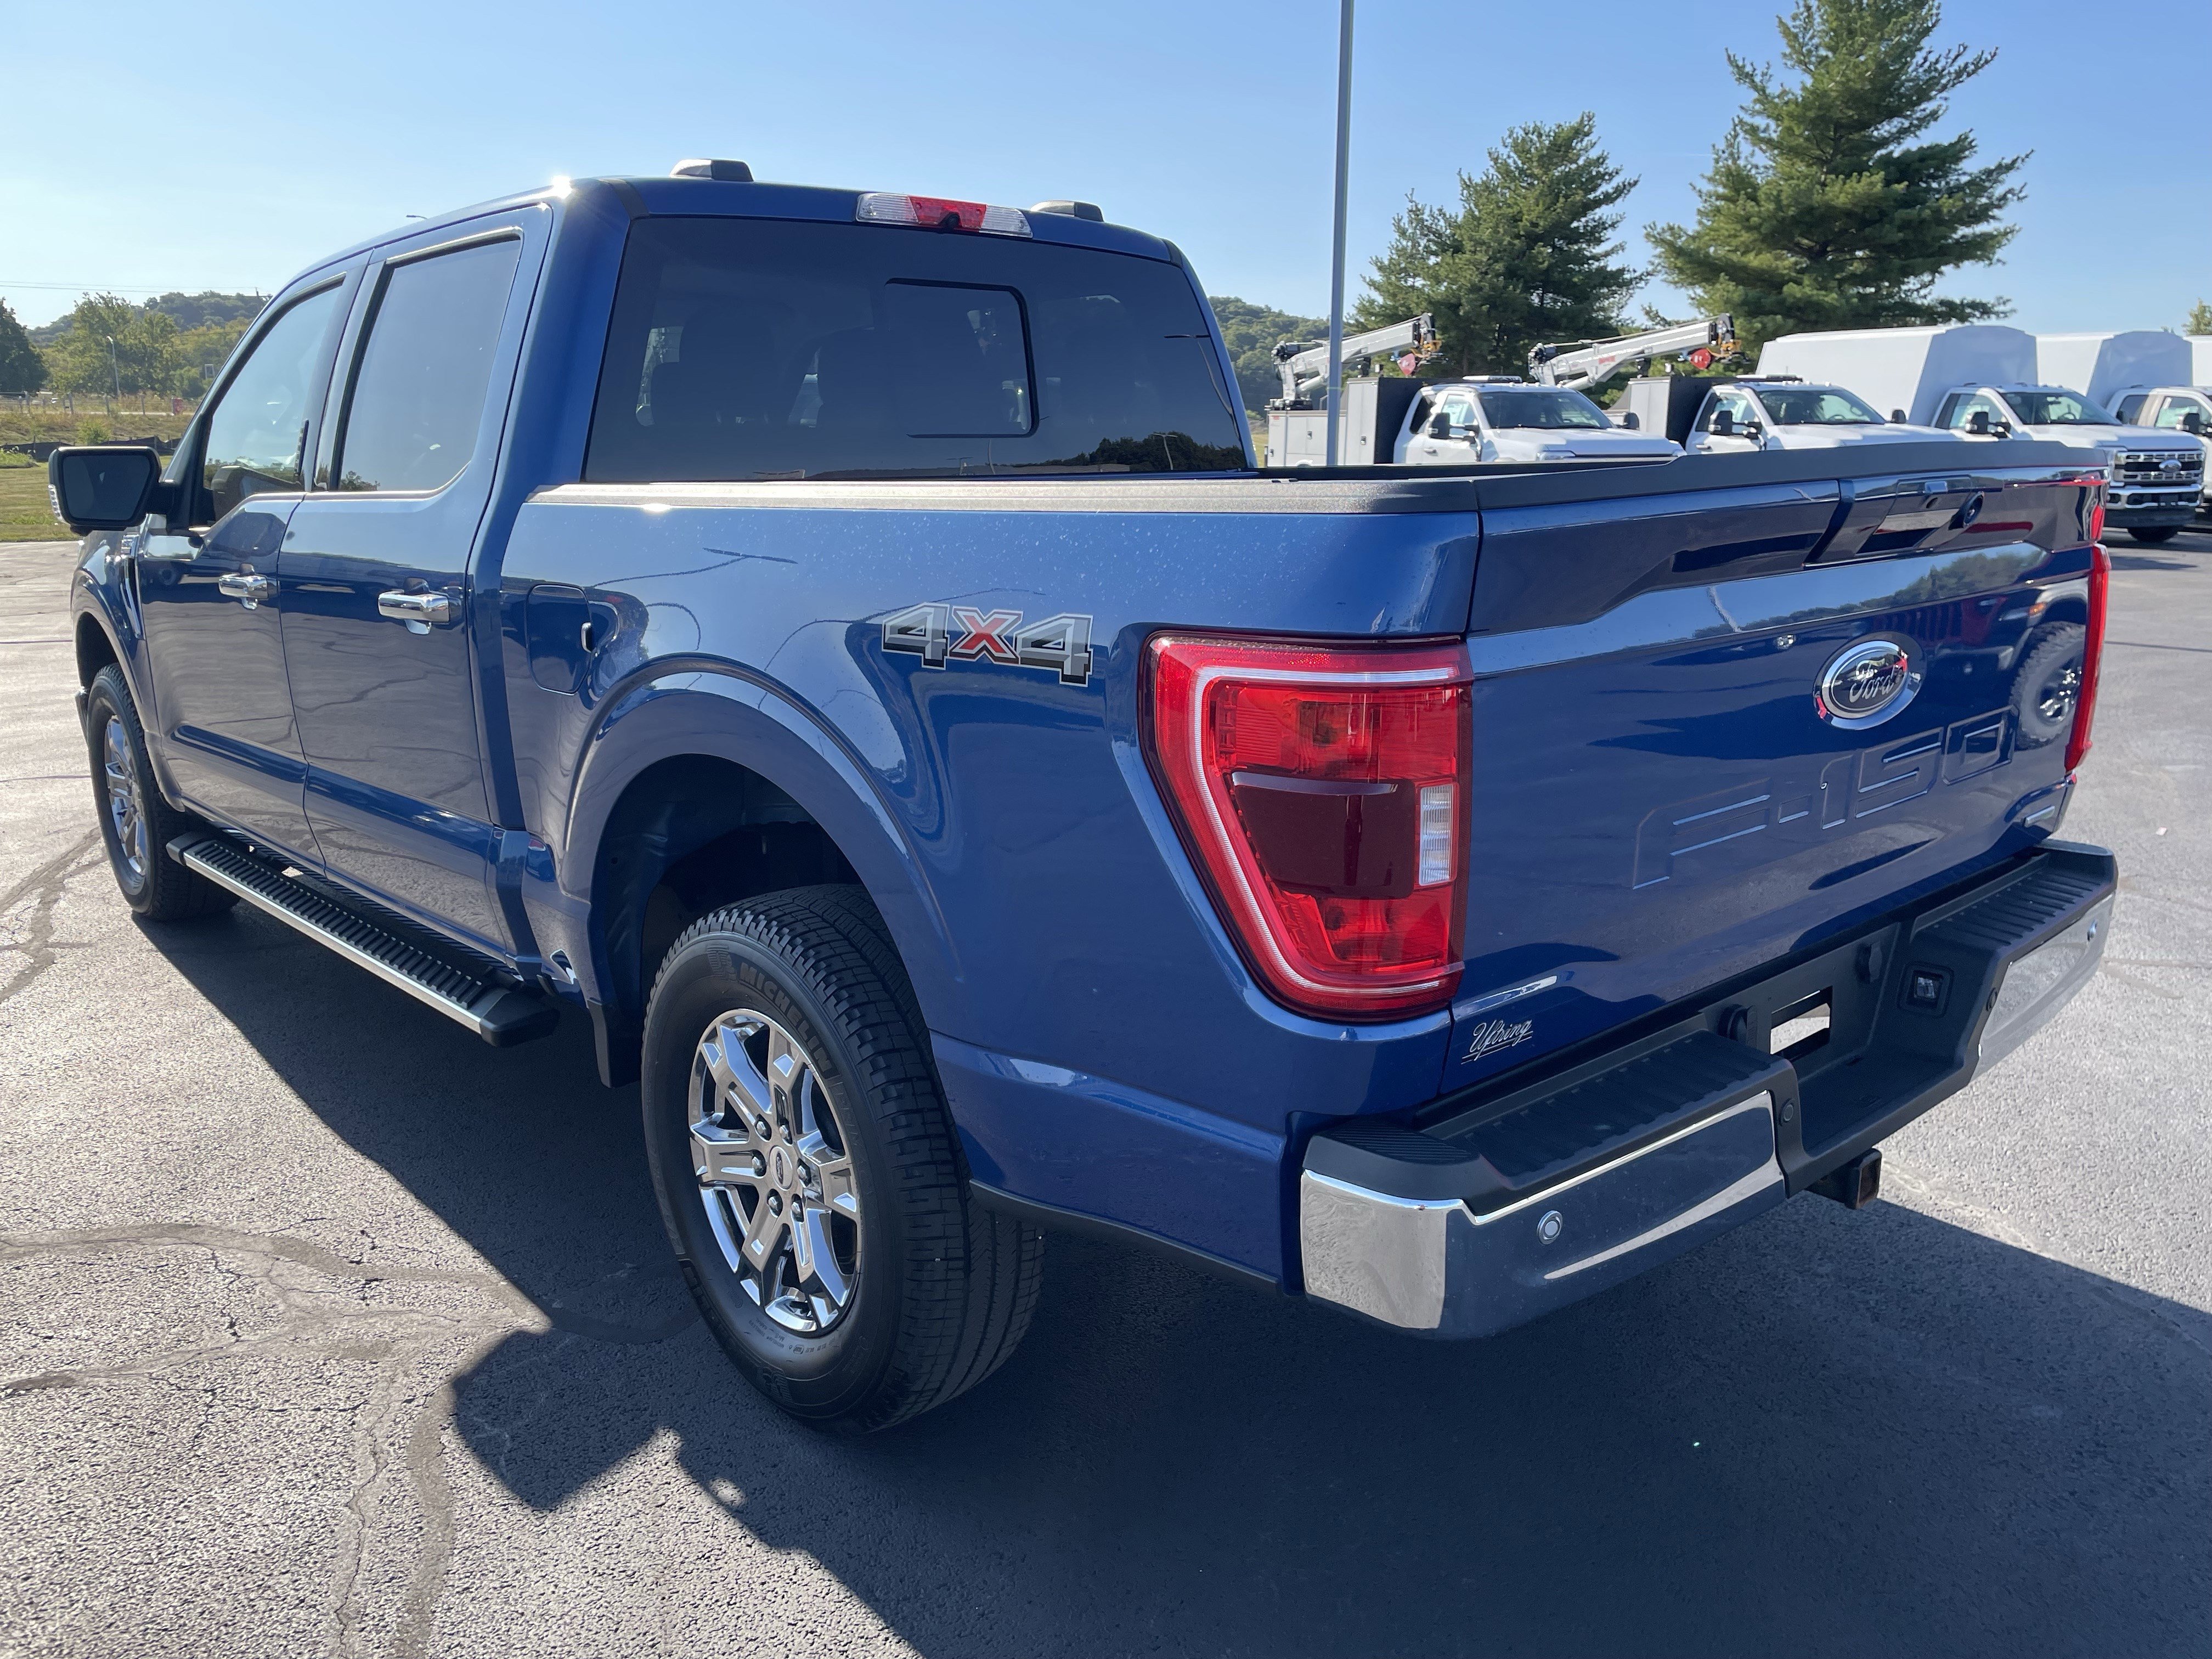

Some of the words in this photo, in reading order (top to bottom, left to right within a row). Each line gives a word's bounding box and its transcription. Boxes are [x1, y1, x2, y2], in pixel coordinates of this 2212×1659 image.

[1848, 658, 1897, 703] Ford
[1633, 706, 2018, 889] F-150
[739, 962, 833, 1073] MICHELIN
[1469, 1019, 1533, 1061] Uftring
